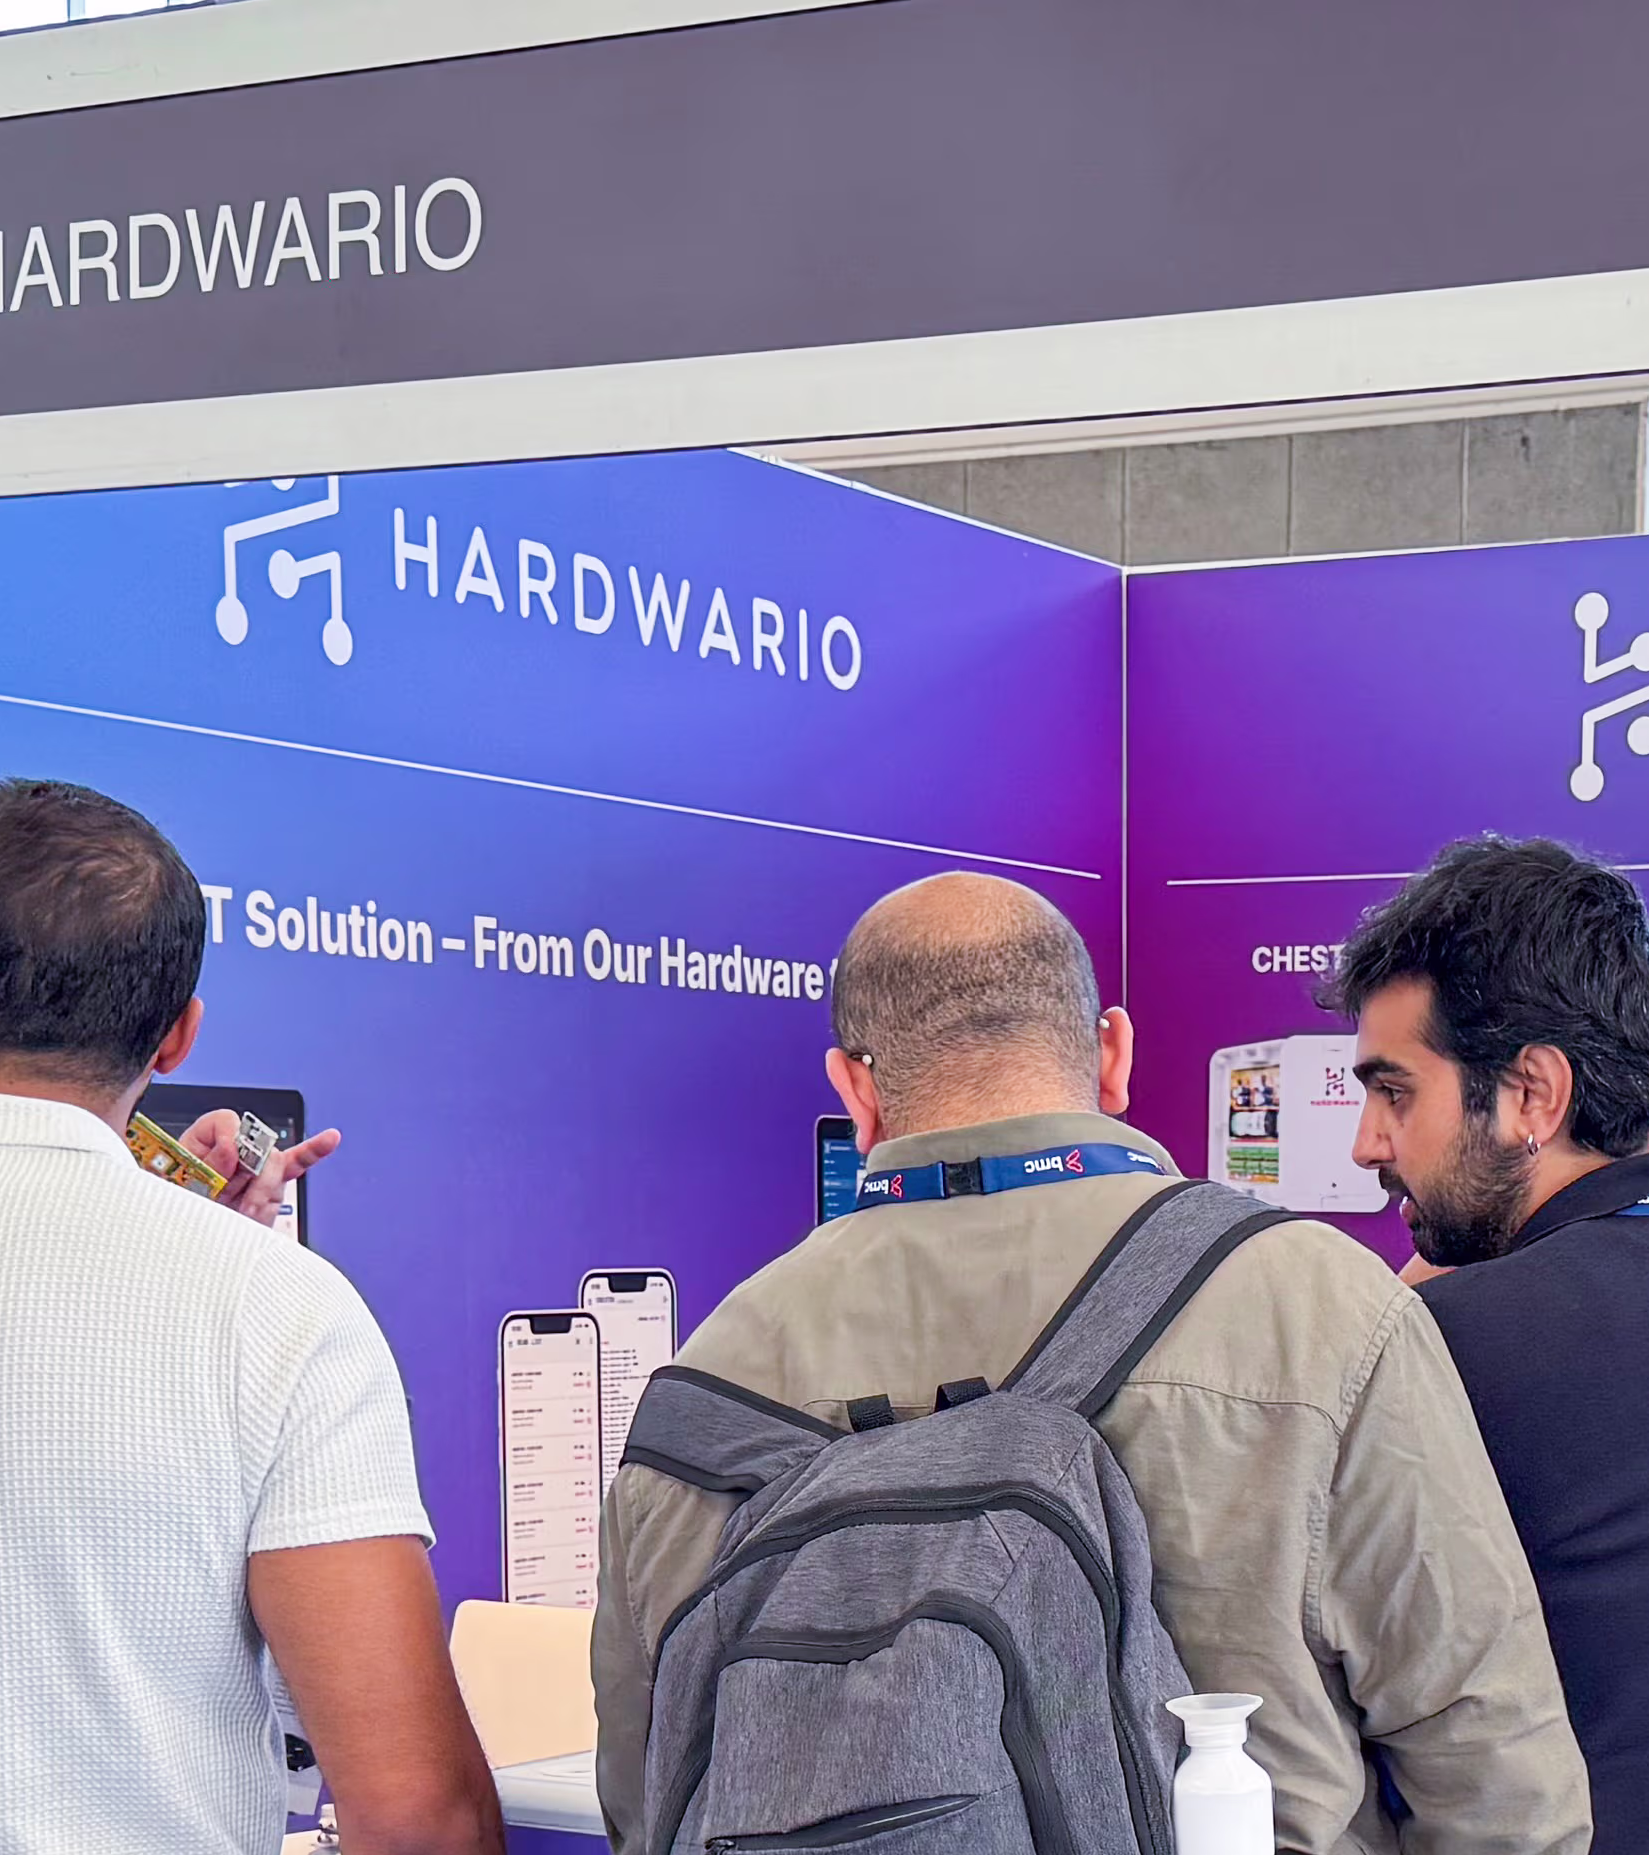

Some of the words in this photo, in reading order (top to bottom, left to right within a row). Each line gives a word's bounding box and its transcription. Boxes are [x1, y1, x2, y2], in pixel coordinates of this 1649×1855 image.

[393, 507, 863, 692] HARDWARIO
[245, 893, 432, 964] Solution
[474, 917, 574, 986] From
[583, 929, 651, 986] Our
[660, 938, 823, 1004] Hardware
[1024, 1155, 1063, 1174] bmc
